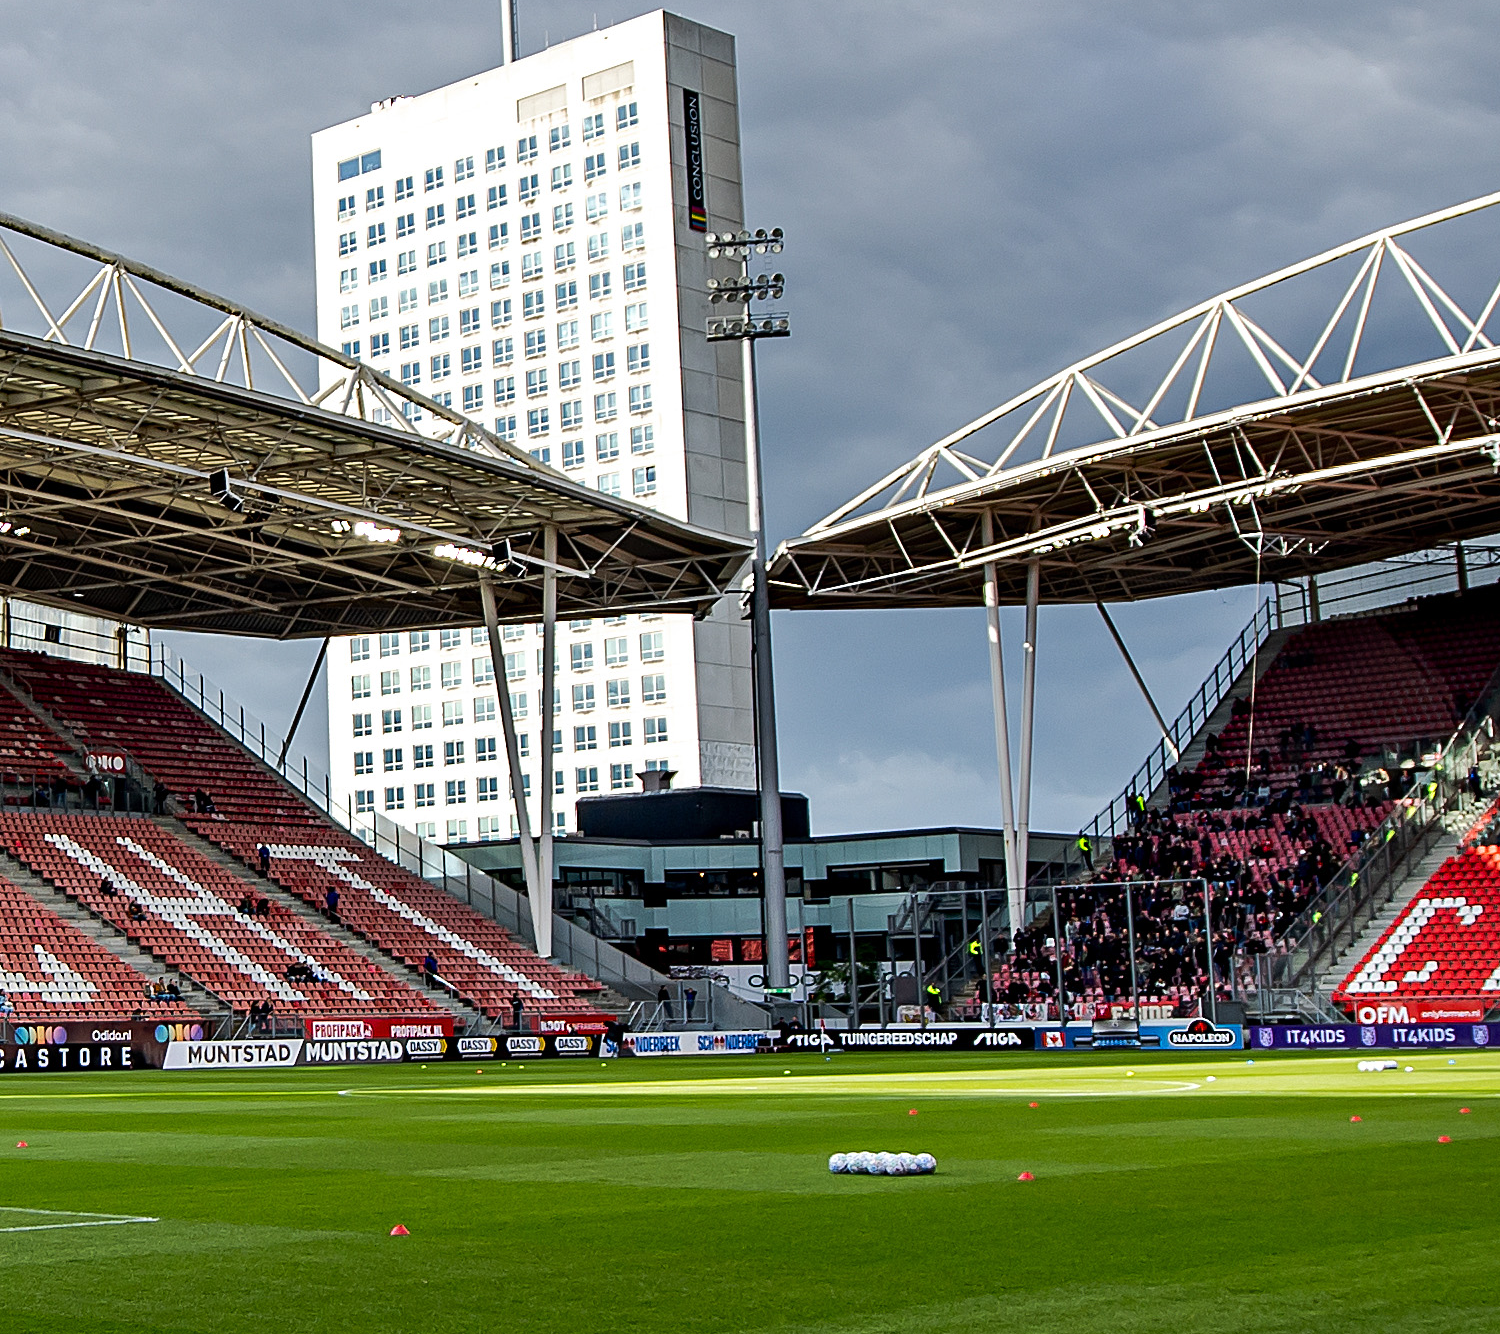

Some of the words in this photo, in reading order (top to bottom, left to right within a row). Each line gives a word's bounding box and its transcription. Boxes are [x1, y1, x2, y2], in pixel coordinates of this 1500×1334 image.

[1358, 1006, 1417, 1024] OFM.
[92, 1029, 132, 1042] Odido.nl
[315, 1023, 363, 1038] PROFIPACK
[1287, 1029, 1346, 1045] IT4KIDS
[1393, 1028, 1456, 1045] IT4KIDS
[510, 1039, 538, 1050] DASSY
[558, 1038, 586, 1050] DASSY
[839, 1032, 958, 1046] TUINGEREEDSCHAP
[972, 1032, 1022, 1046] STIGA
[1172, 1033, 1230, 1043] NAPOLEON
[306, 1041, 403, 1062] MUNTSTAD
[410, 1040, 439, 1052] DASSY
[461, 1040, 489, 1051] DASSY
[188, 1044, 290, 1064] MUNTSTAD
